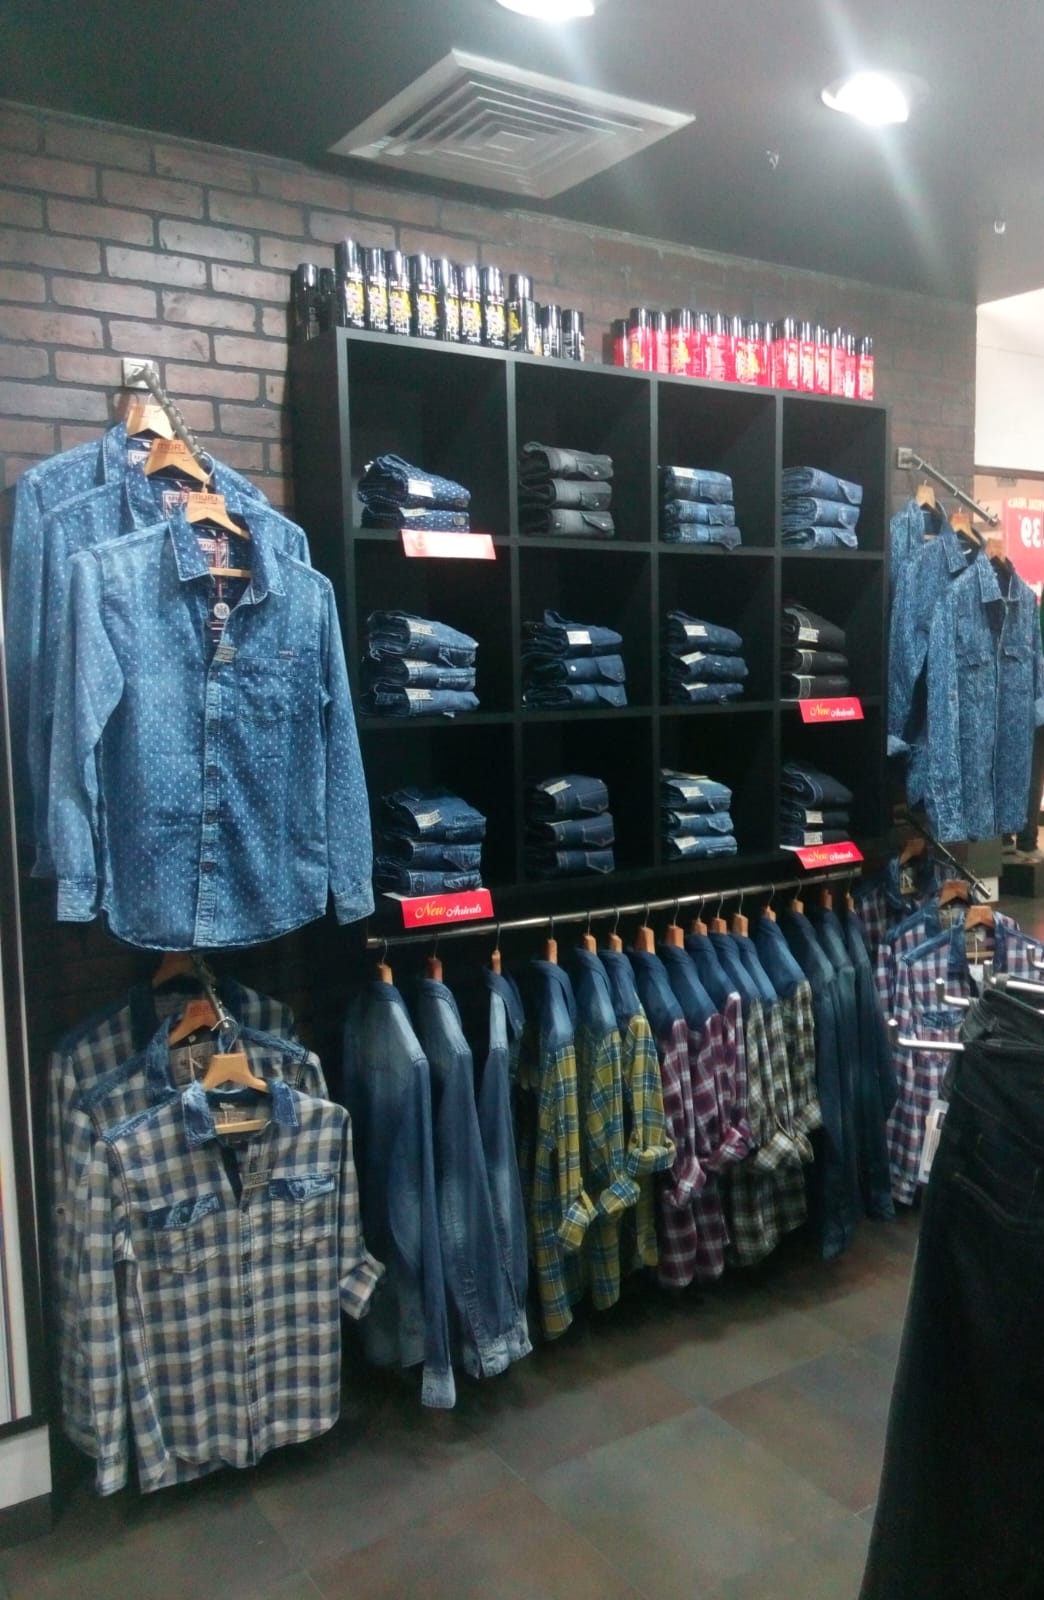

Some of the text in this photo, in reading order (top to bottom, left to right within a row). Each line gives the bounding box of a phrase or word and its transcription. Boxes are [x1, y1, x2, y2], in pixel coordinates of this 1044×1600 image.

[810, 703, 829, 716] New
[808, 849, 827, 862] New
[415, 901, 482, 919] New Arrivals
